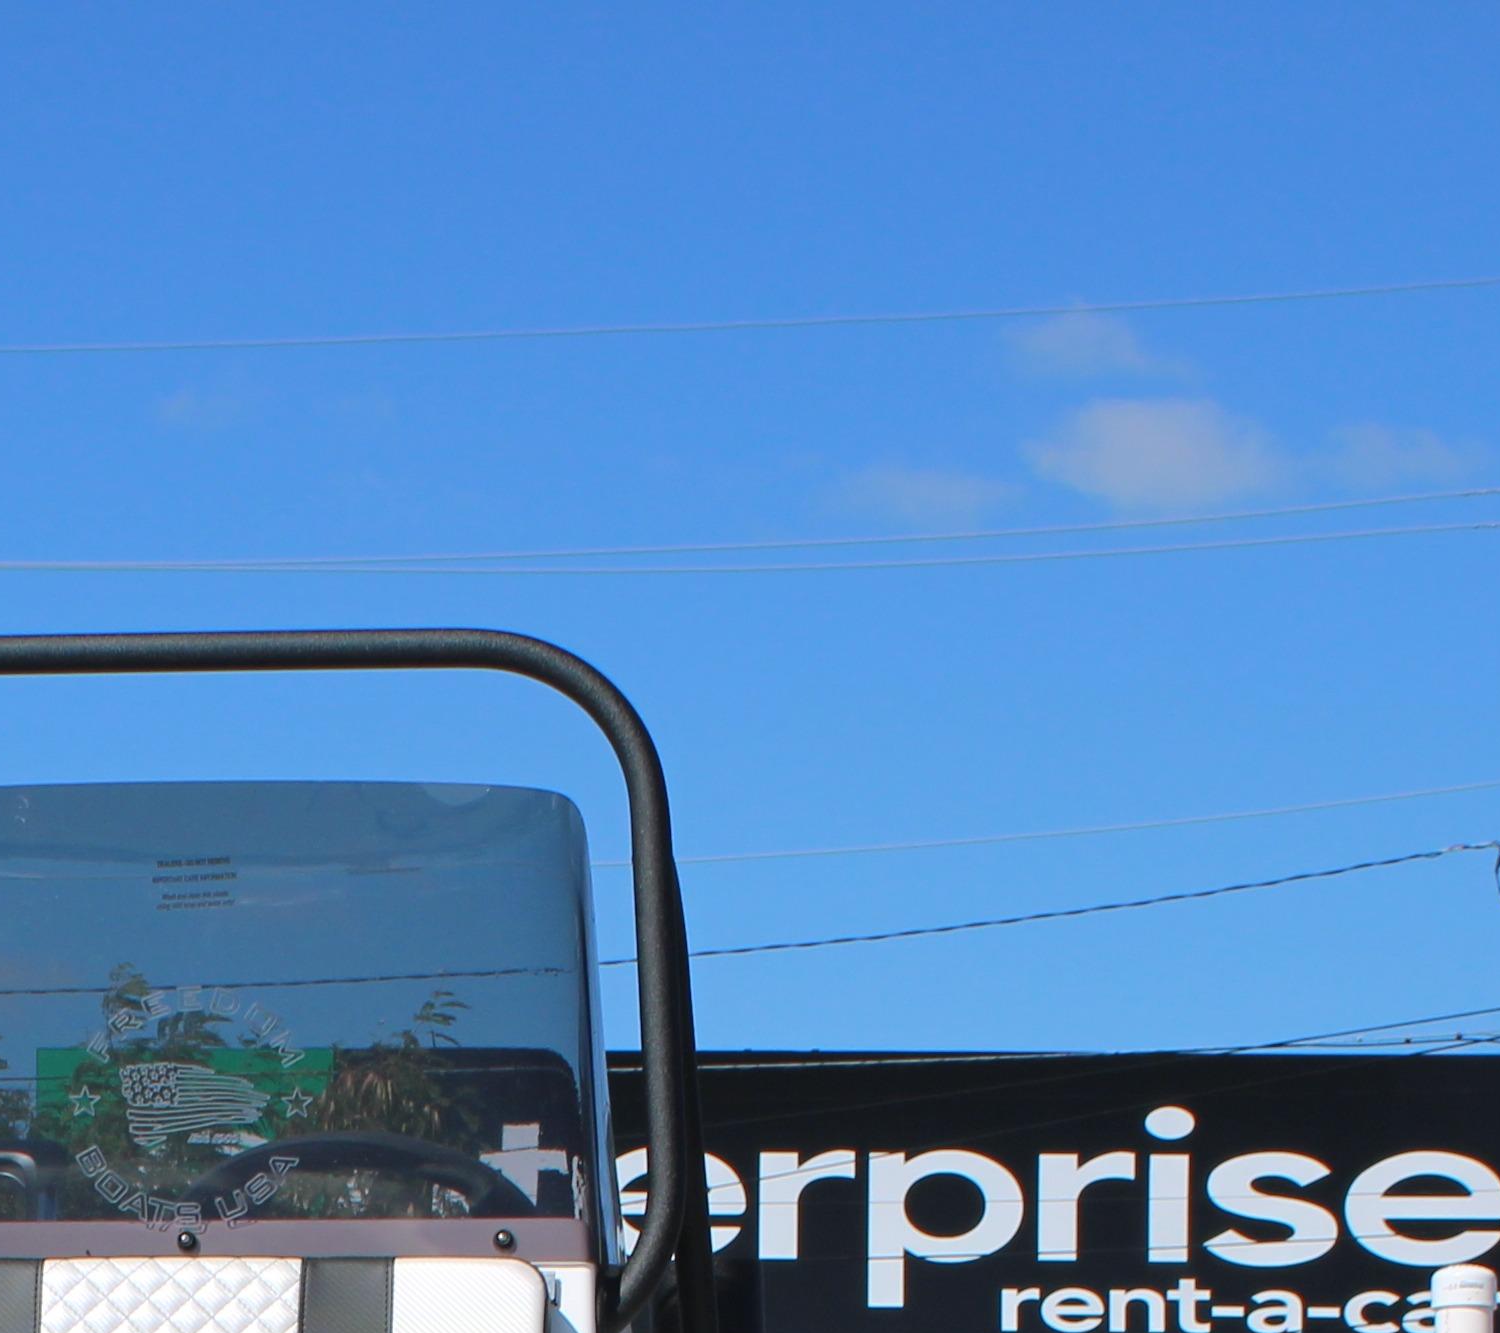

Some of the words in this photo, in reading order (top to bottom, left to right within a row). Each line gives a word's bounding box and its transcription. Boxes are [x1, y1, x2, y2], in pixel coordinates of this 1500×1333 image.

[86, 985, 305, 1069] FREEDOM
[75, 1145, 202, 1227] BOATS
[214, 1155, 299, 1221] USA
